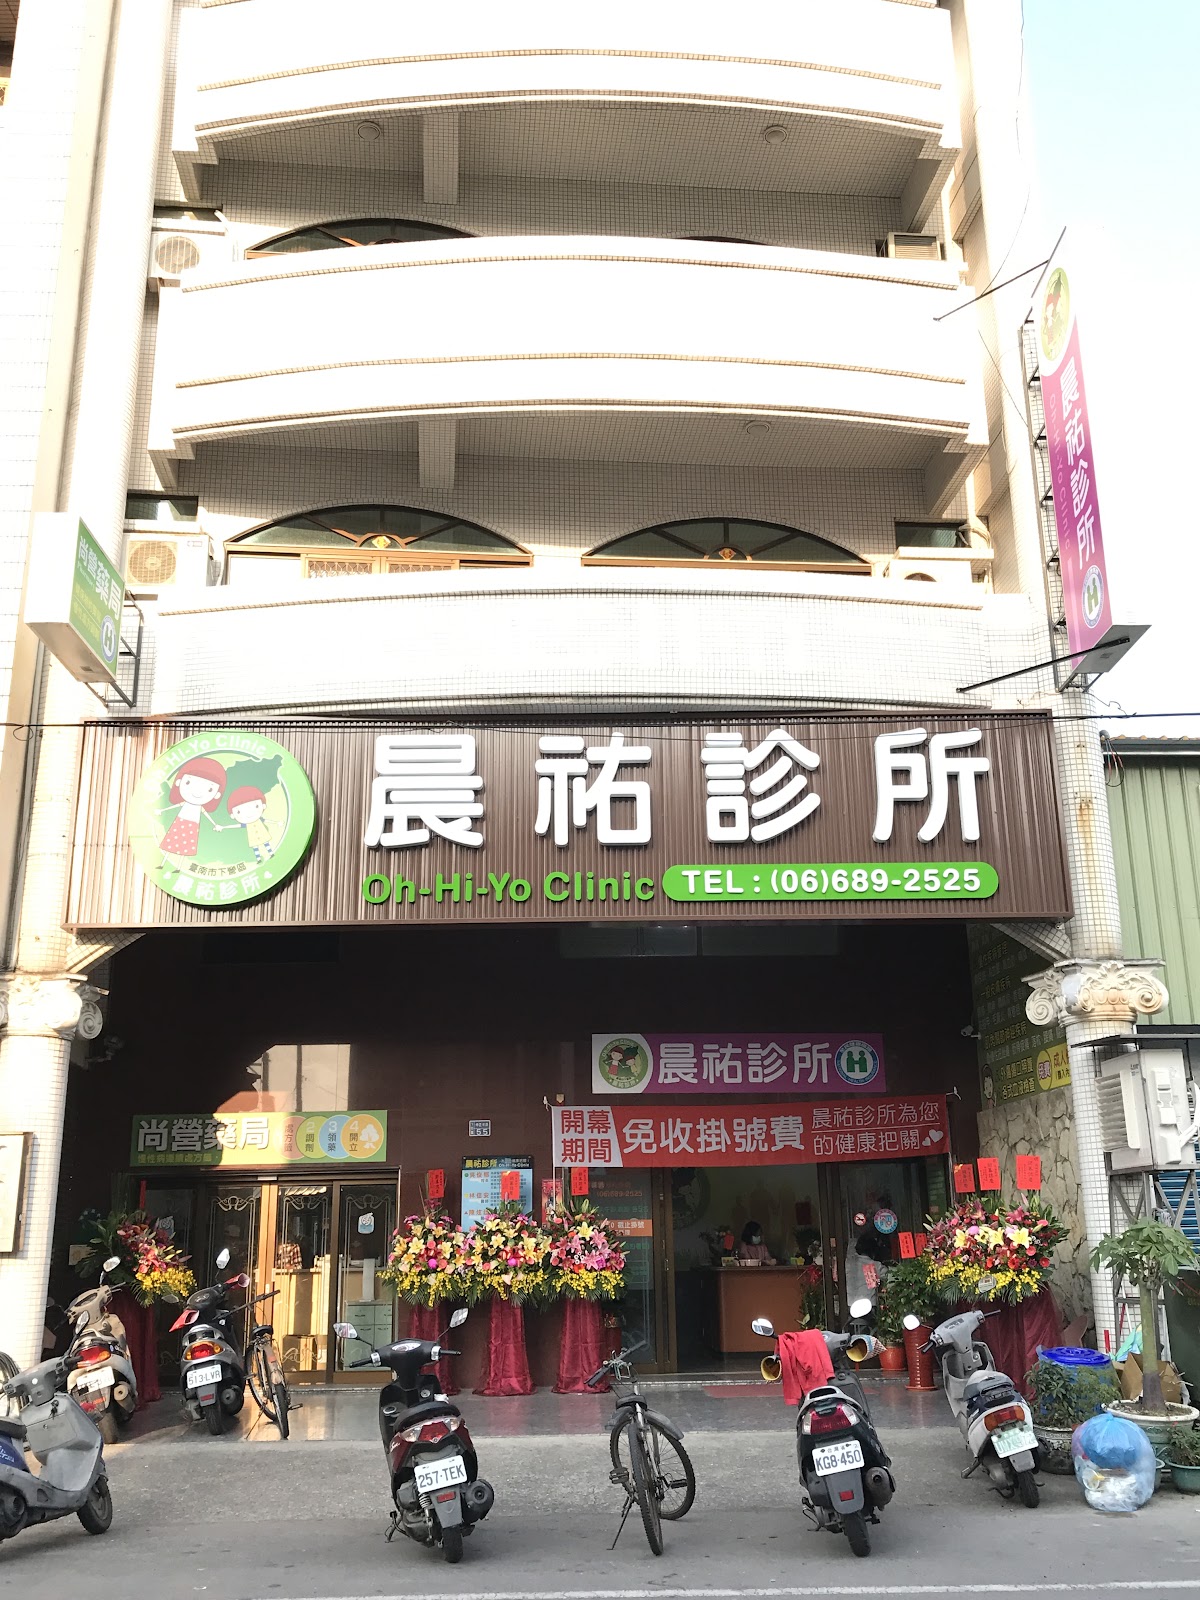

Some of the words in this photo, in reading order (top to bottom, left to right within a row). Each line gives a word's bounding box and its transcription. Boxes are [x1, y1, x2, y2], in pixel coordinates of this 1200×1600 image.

[1060, 356, 1094, 570] 晨祐診所
[363, 728, 990, 849] 晨祐診所
[171, 872, 262, 901] 晨祐診所
[363, 870, 532, 905] Oh-Hi-Yo
[544, 869, 655, 904] Clinic
[769, 866, 982, 894] (06)689-2525
[657, 1041, 832, 1085] 晨祐診所
[306, 1121, 315, 1133] 2
[328, 1120, 338, 1132] 3
[349, 1120, 359, 1132] 4
[560, 1109, 611, 1136] 開幕
[811, 1100, 941, 1130] 晨祐診所為您
[137, 1116, 270, 1153] 尚營藥局
[349, 1132, 359, 1152] 開立
[622, 1115, 805, 1155] 免收掛號費
[813, 1128, 921, 1156] 的健康把關
[560, 1137, 612, 1164] 期間
